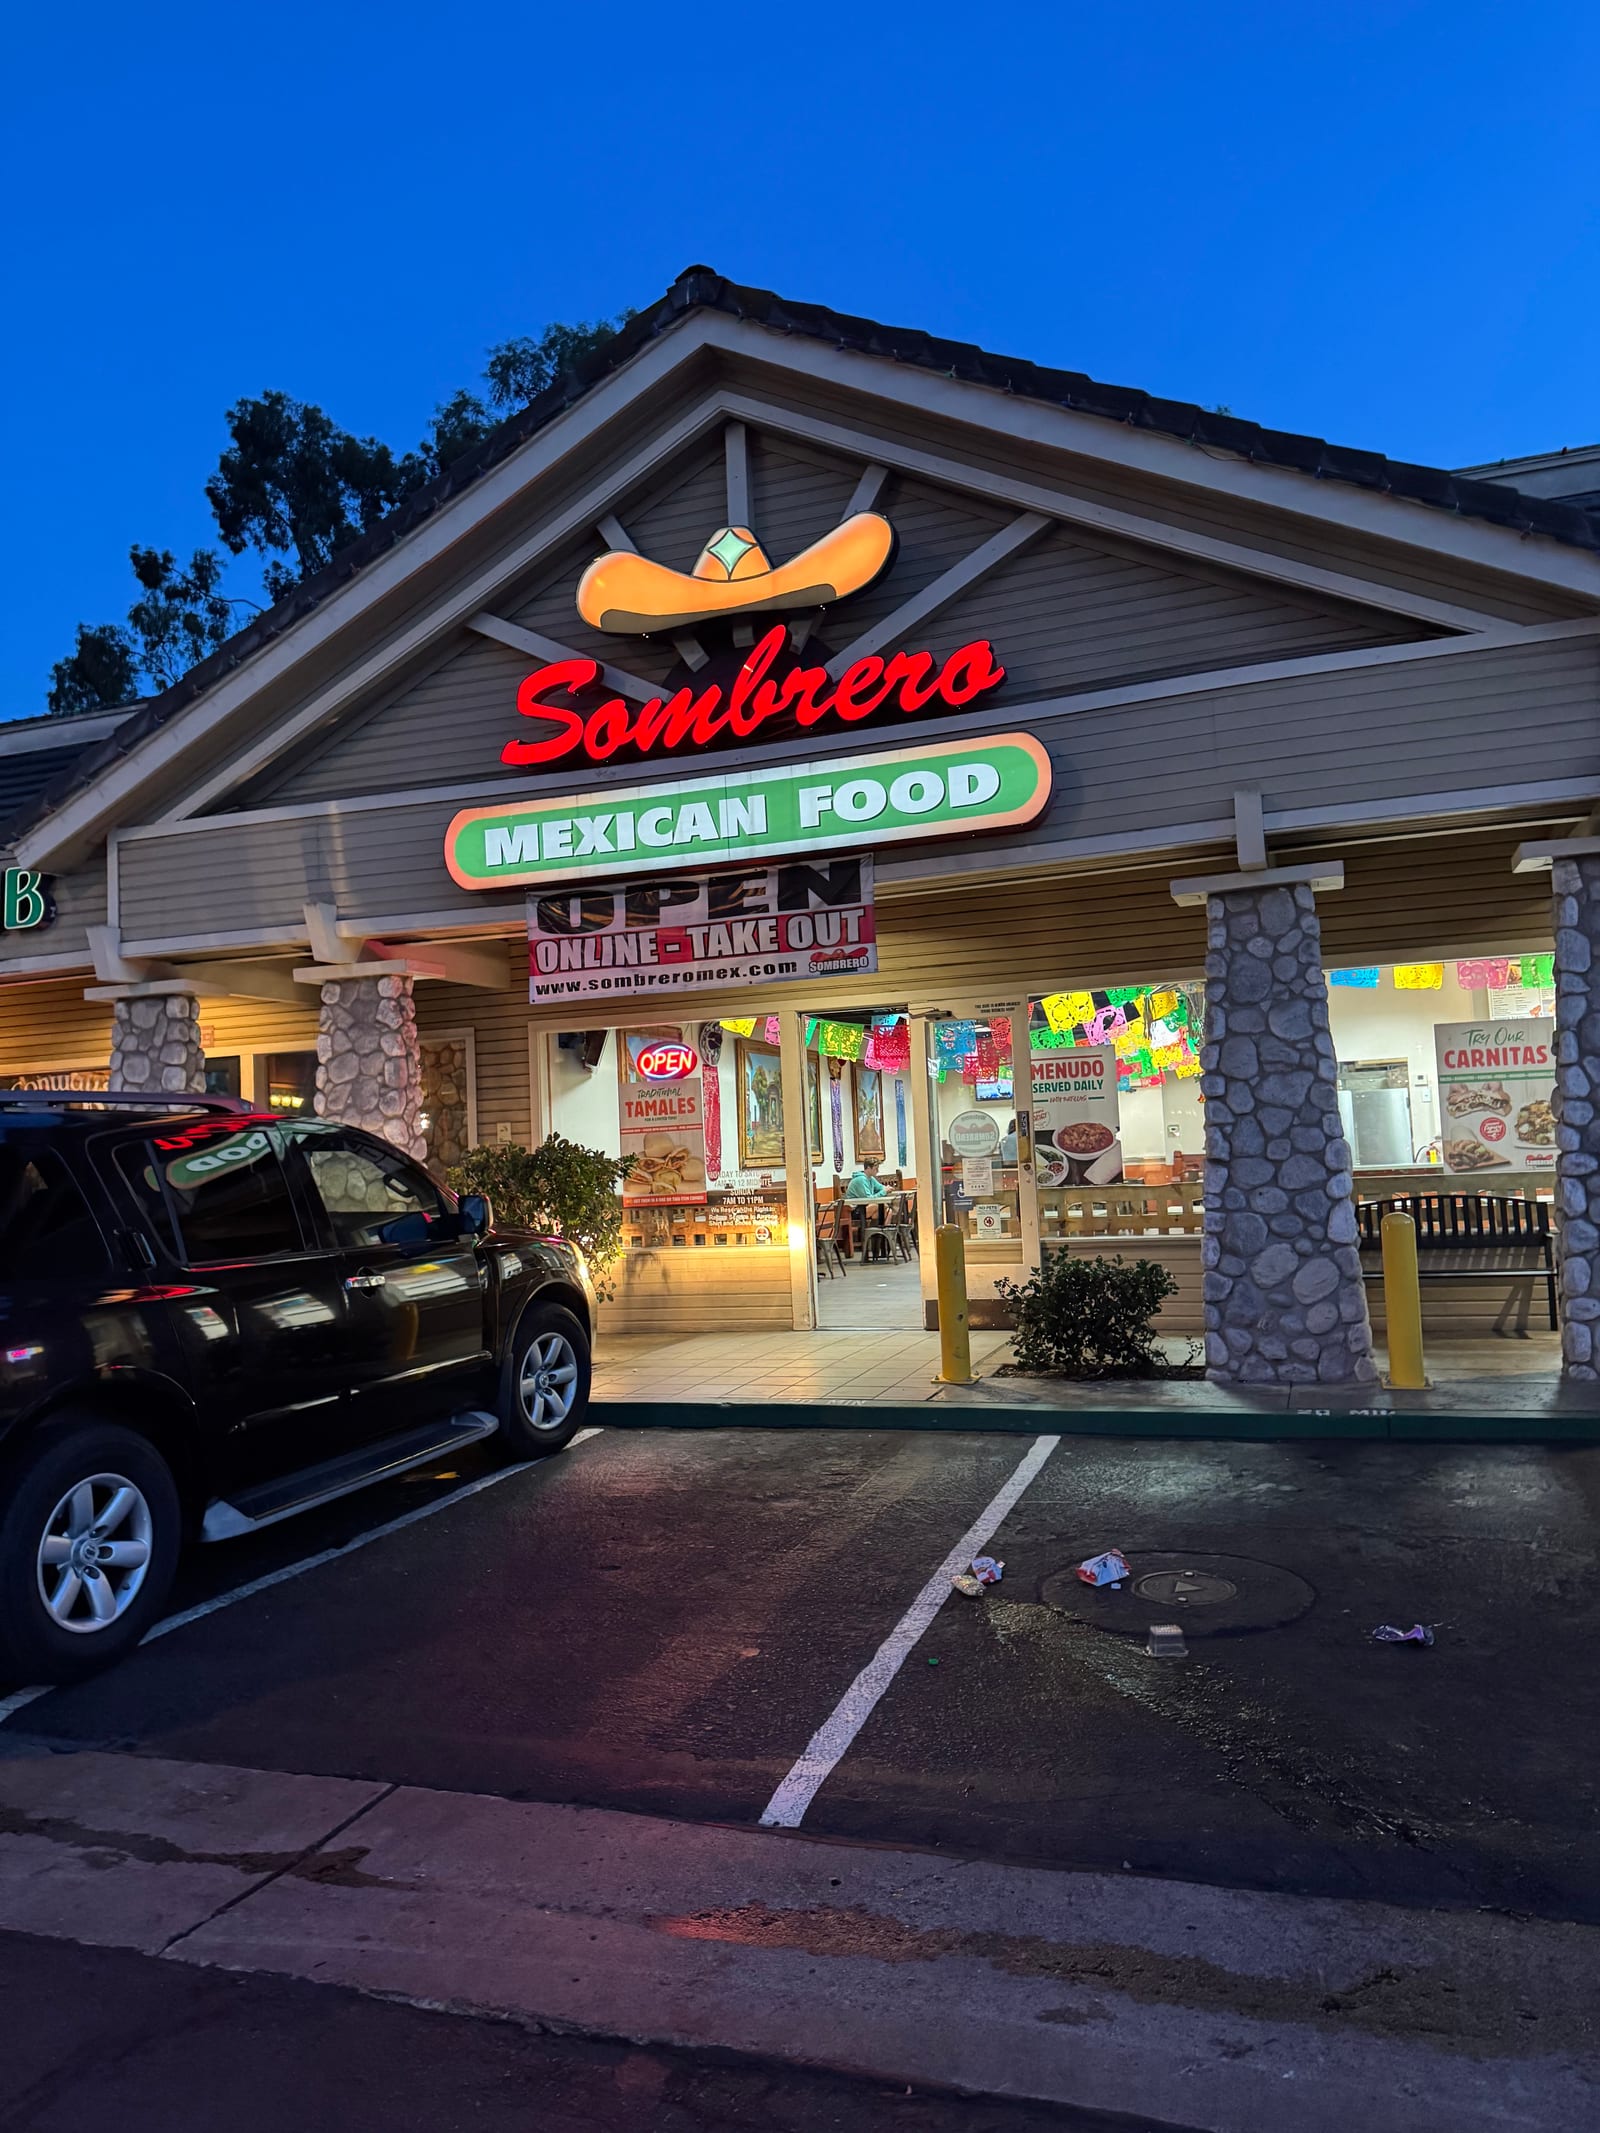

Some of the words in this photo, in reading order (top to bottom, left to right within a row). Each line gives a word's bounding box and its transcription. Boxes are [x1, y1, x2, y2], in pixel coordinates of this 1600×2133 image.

[501, 624, 1005, 766] Sombrero
[484, 795, 767, 867] MEXICAN
[799, 763, 1000, 828] FOOD
[536, 858, 863, 935] OPEN
[535, 930, 659, 974] ONLINE
[686, 916, 779, 959] TAKE
[787, 907, 866, 949] OUT
[809, 956, 869, 973] SOMBRERO
[535, 960, 798, 995] www.sombreromex.com
[640, 1050, 693, 1073] OPEN
[1443, 1045, 1548, 1069] CARNITAS
[1030, 1060, 1104, 1080] MENUDO
[1032, 1081, 1071, 1093] SERVED
[1073, 1079, 1104, 1091] DAILY
[625, 1096, 696, 1118] TAMALES
[722, 1197, 736, 1205] 7AM
[737, 1196, 746, 1205] TO
[747, 1195, 764, 1204] 11PM
